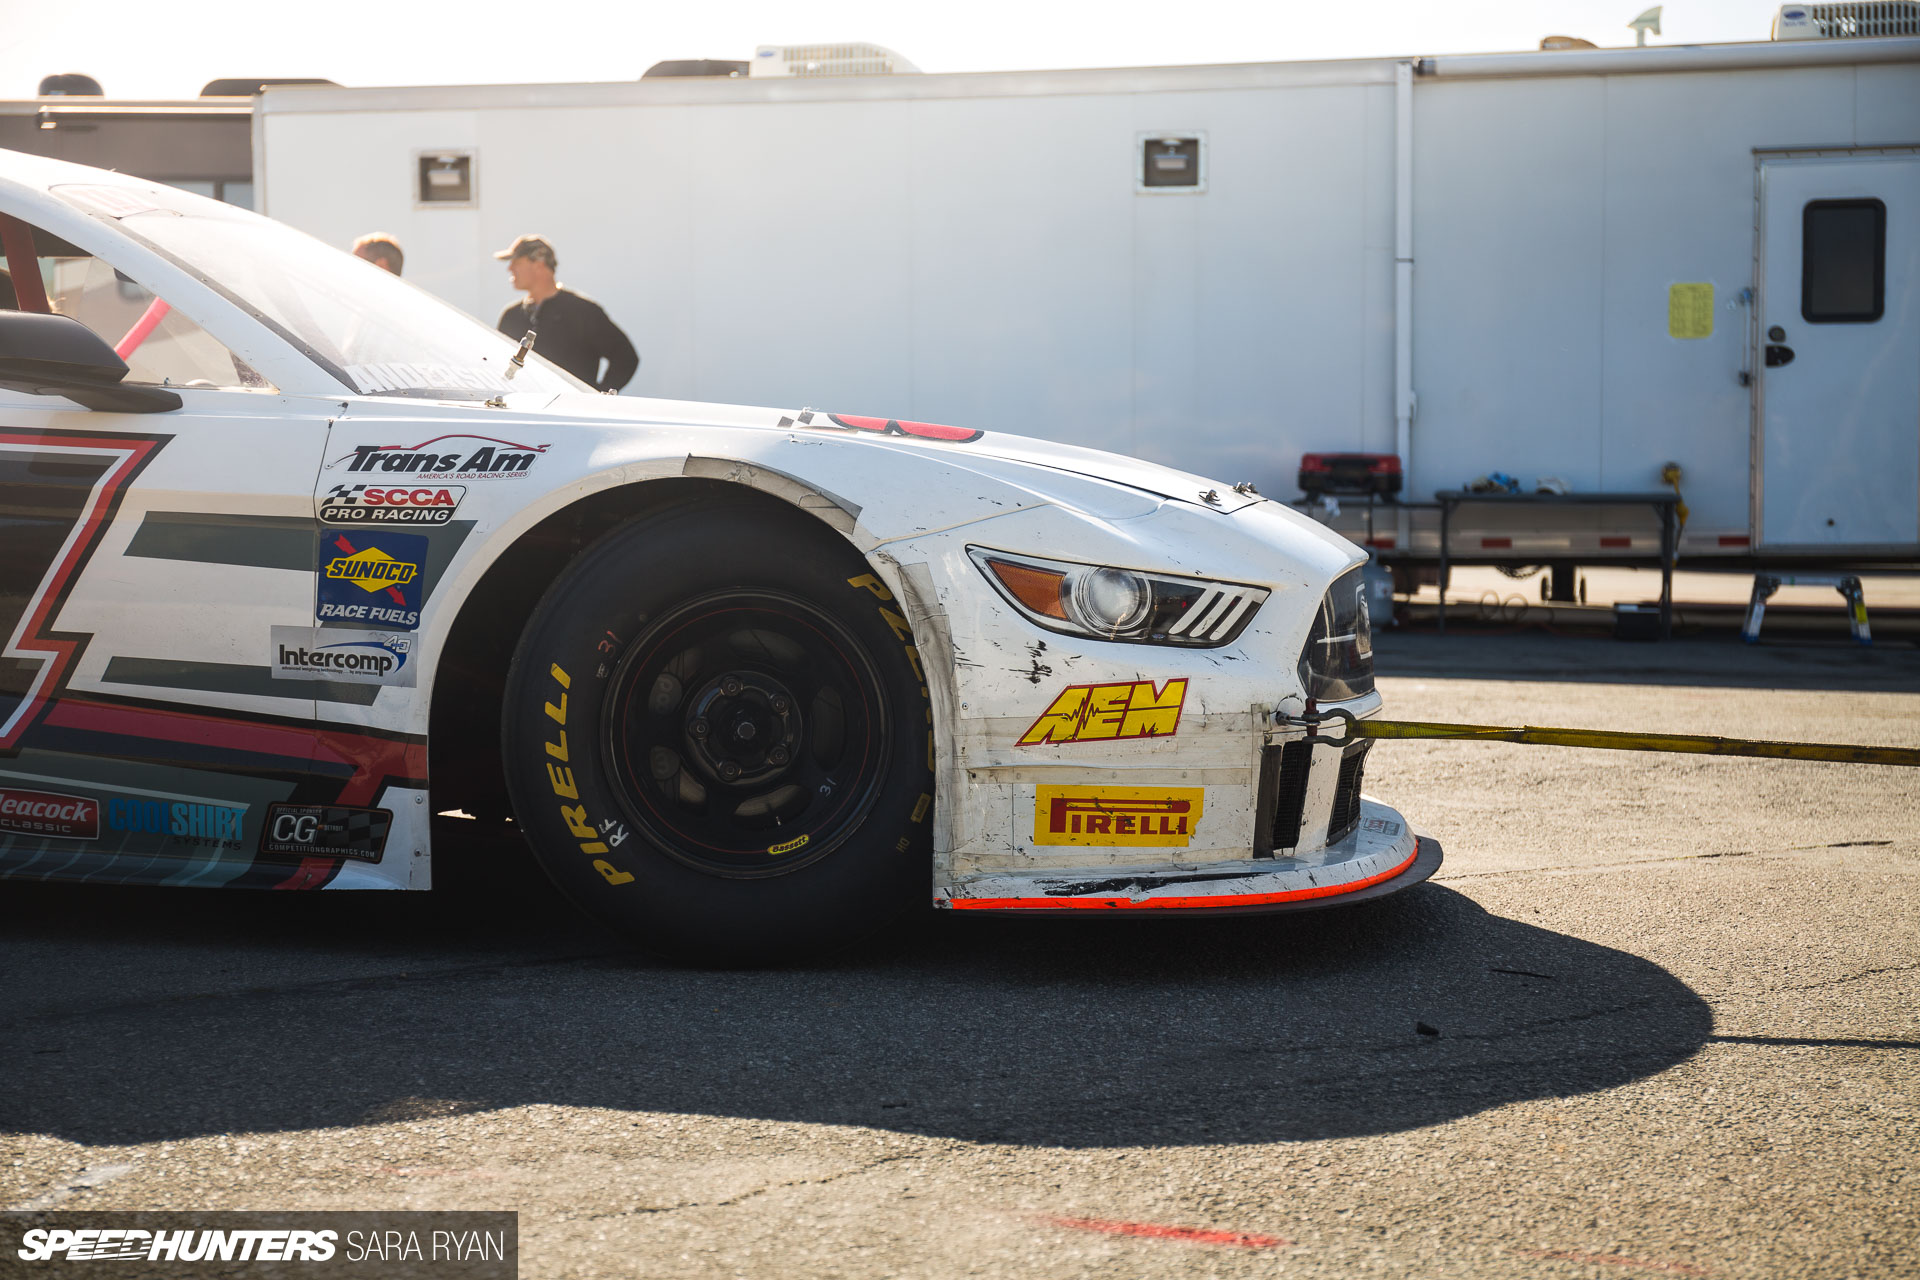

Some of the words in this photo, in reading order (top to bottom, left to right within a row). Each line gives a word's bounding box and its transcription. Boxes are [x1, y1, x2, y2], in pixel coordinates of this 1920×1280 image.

[347, 446, 461, 473] Trans
[456, 447, 536, 473] Am
[416, 472, 454, 480] AMERICA'S
[456, 472, 477, 480] ROAD
[477, 471, 504, 479] RACING
[363, 489, 455, 506] SCCA
[324, 508, 366, 519] PRO
[371, 509, 449, 521] RACING
[327, 559, 416, 583] SUNOCO
[320, 603, 368, 618] RACE
[368, 606, 418, 625] FUELS
[279, 643, 393, 677] Intercomp
[1014, 678, 1189, 747] AEM
[545, 662, 635, 886] PIRELLI
[0, 794, 92, 822] eacock
[1050, 797, 1191, 834] PIRELLI
[273, 815, 318, 843] CG
[173, 836, 242, 851] SYSTEMS
[269, 844, 375, 858] COMPETITIONGRAPHICS.COM
[772, 836, 806, 852] Bassett
